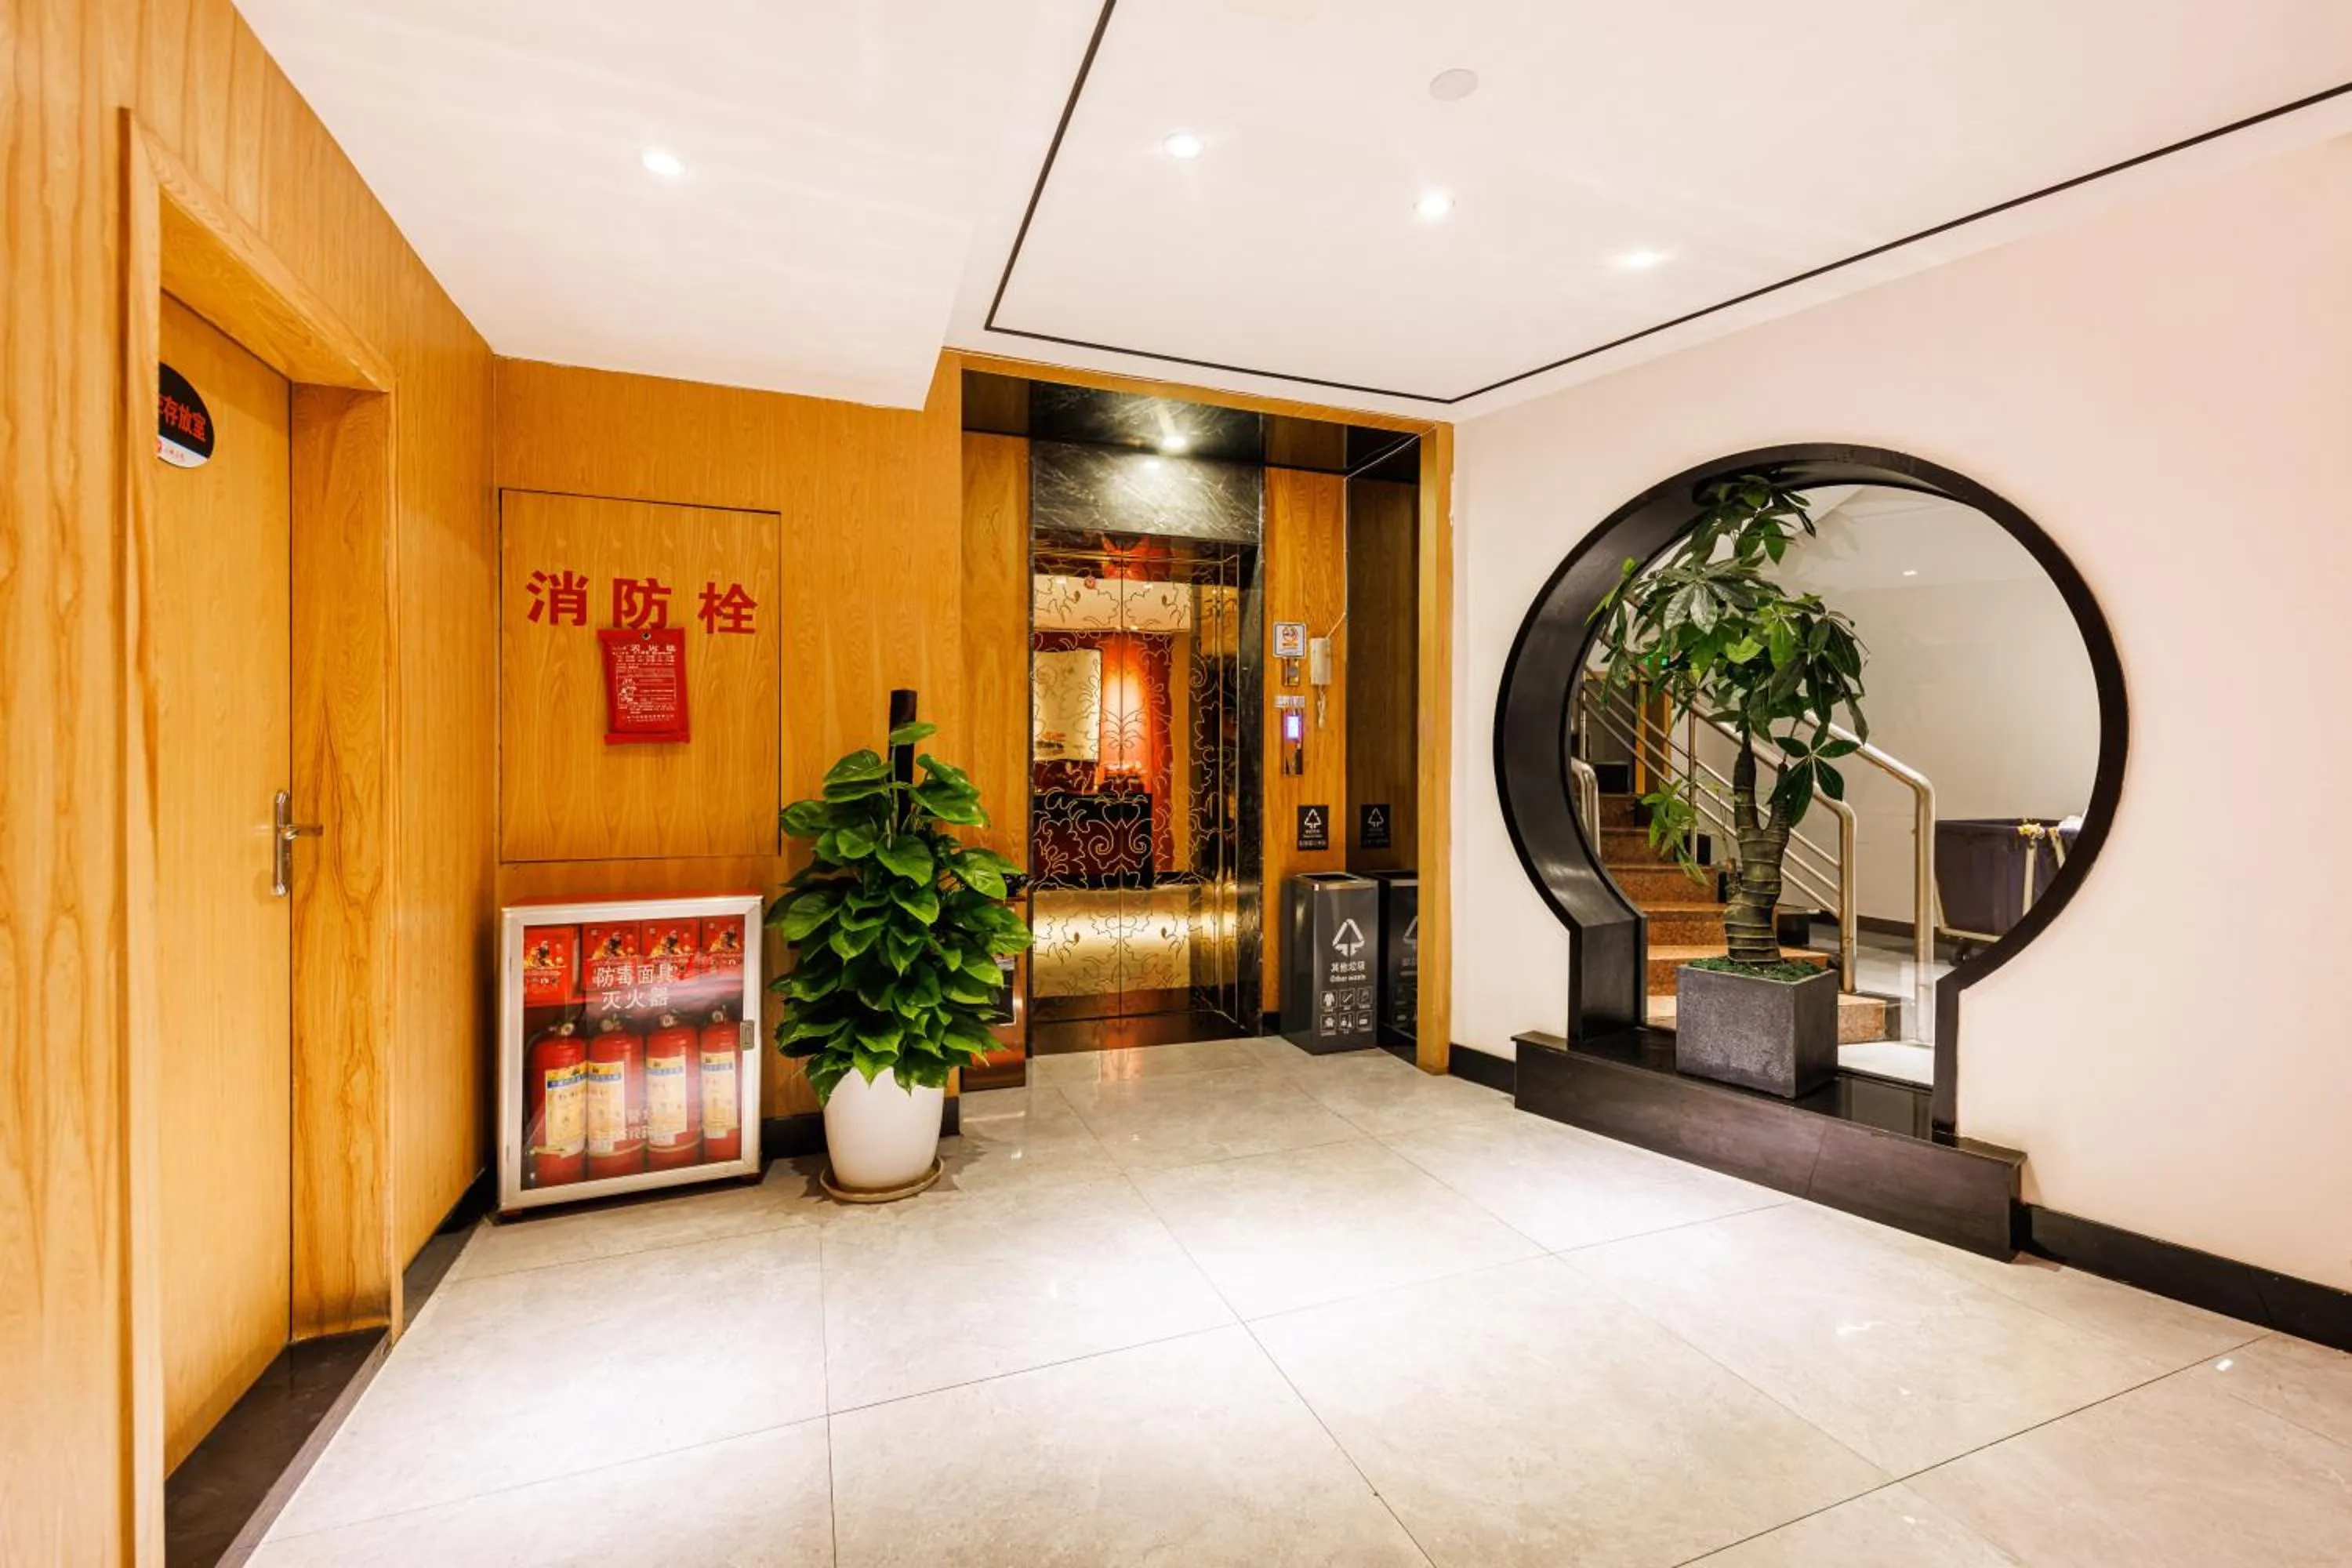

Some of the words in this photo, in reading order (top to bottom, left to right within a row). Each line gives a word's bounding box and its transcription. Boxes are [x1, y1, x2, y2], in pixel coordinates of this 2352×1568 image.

[525, 570, 757, 634] 消防栓
[593, 963, 675, 988] 防毒面具
[1330, 960, 1366, 973] 其他垃圾
[601, 986, 669, 1011] 灭火器
